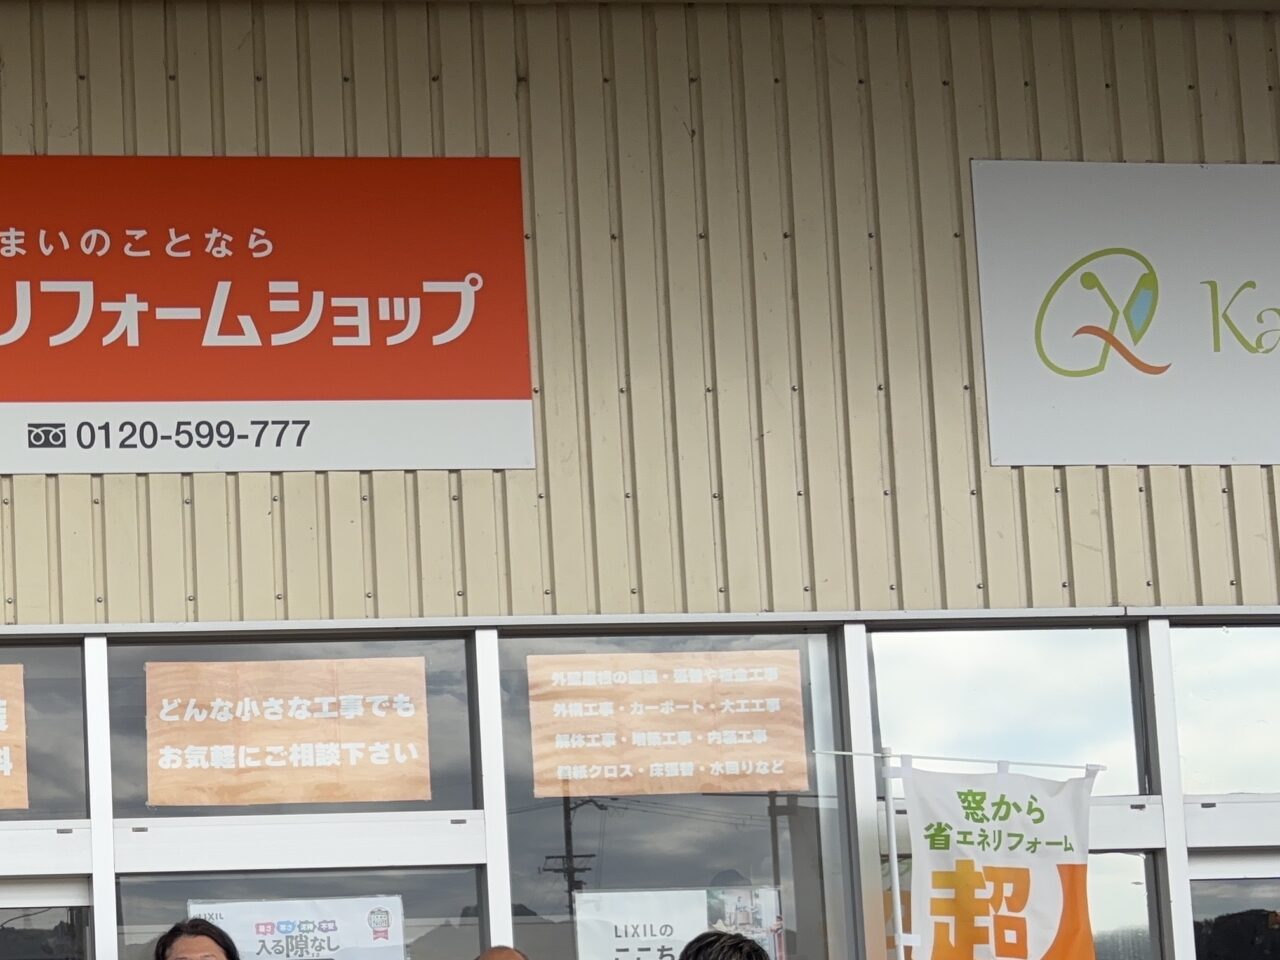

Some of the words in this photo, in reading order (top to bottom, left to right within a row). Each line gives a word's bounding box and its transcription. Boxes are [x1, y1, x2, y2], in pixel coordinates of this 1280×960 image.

[75, 420, 311, 450] 0120-599-777
[158, 693, 416, 722] どんな小さな工事でも
[157, 742, 419, 770] お気軽にご相談下さい
[957, 789, 1045, 824] 窓から
[924, 822, 1074, 853] 省エネリフォーム
[614, 923, 674, 938] LIXILの
[256, 935, 340, 958] 入る隙なし
